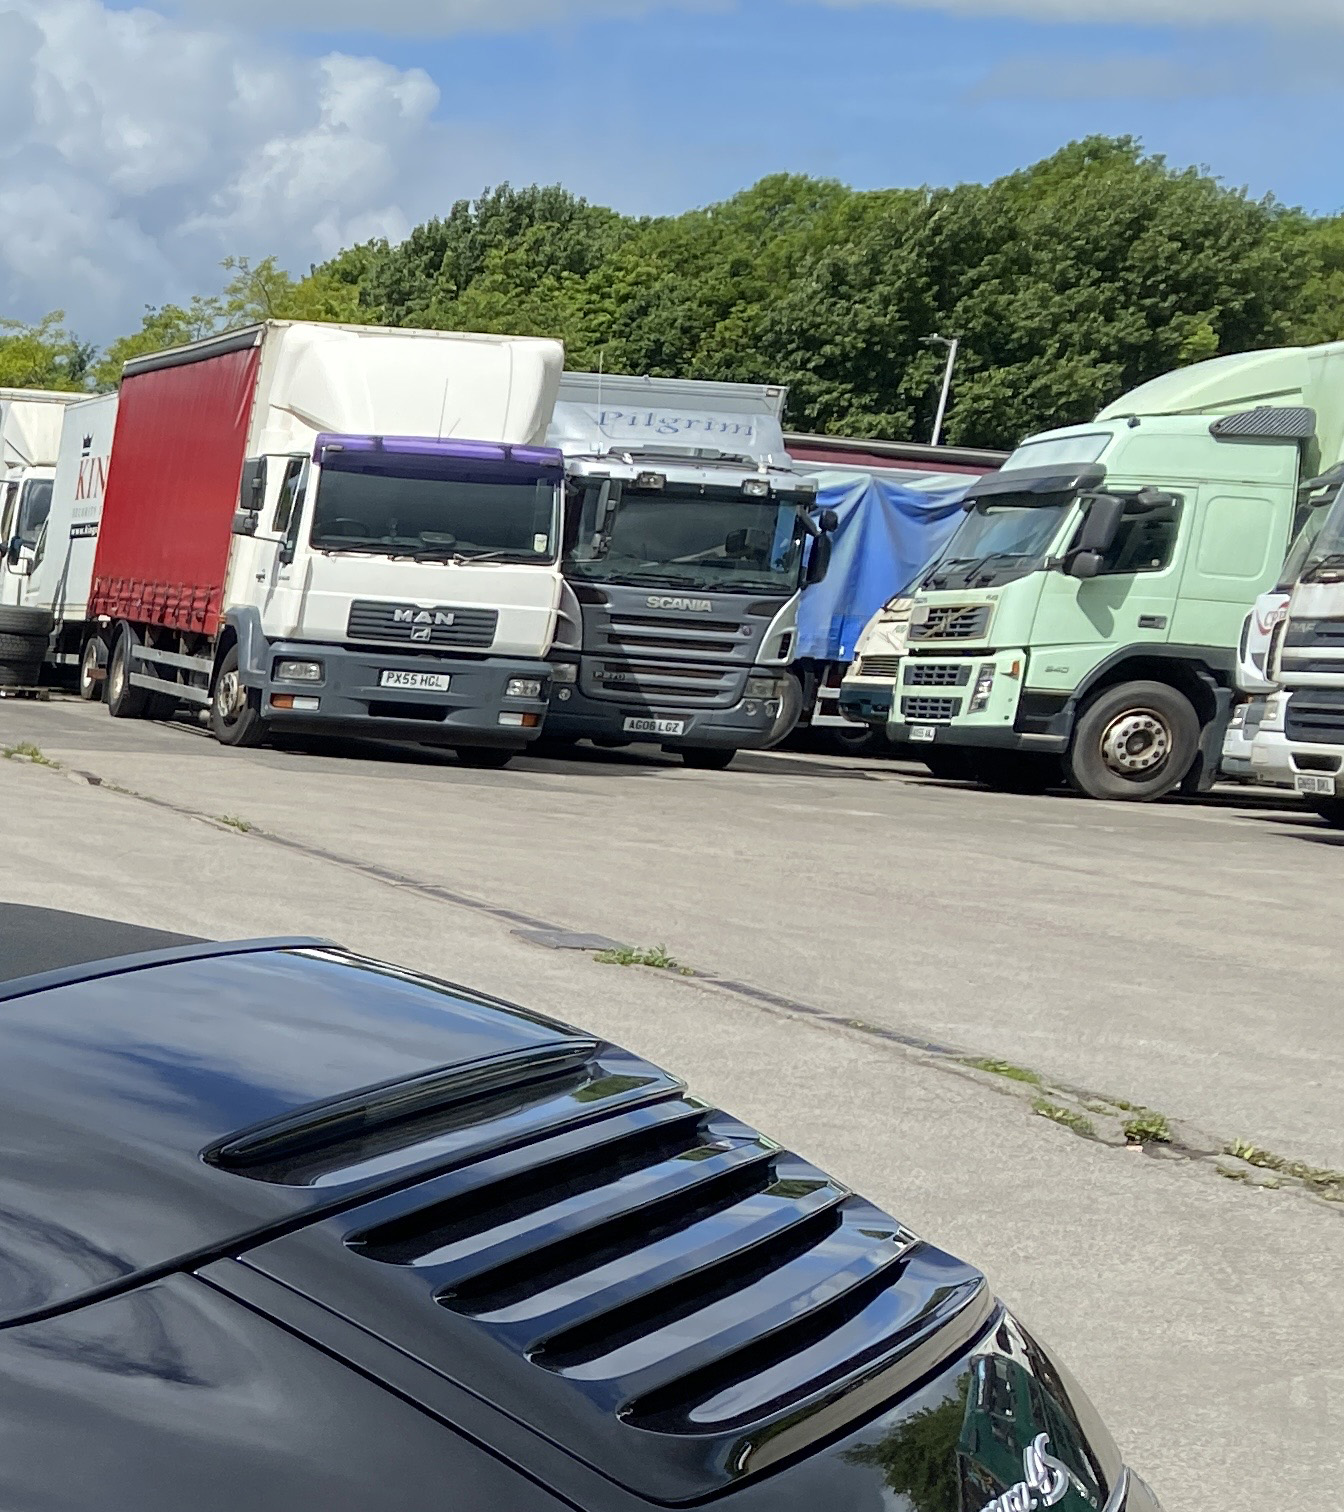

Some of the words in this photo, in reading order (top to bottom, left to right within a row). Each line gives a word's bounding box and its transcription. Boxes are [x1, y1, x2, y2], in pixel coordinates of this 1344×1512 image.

[599, 410, 753, 436] Pilgrim
[646, 595, 712, 613] SCANIA
[393, 609, 454, 626] MAN
[386, 672, 418, 685] PX55
